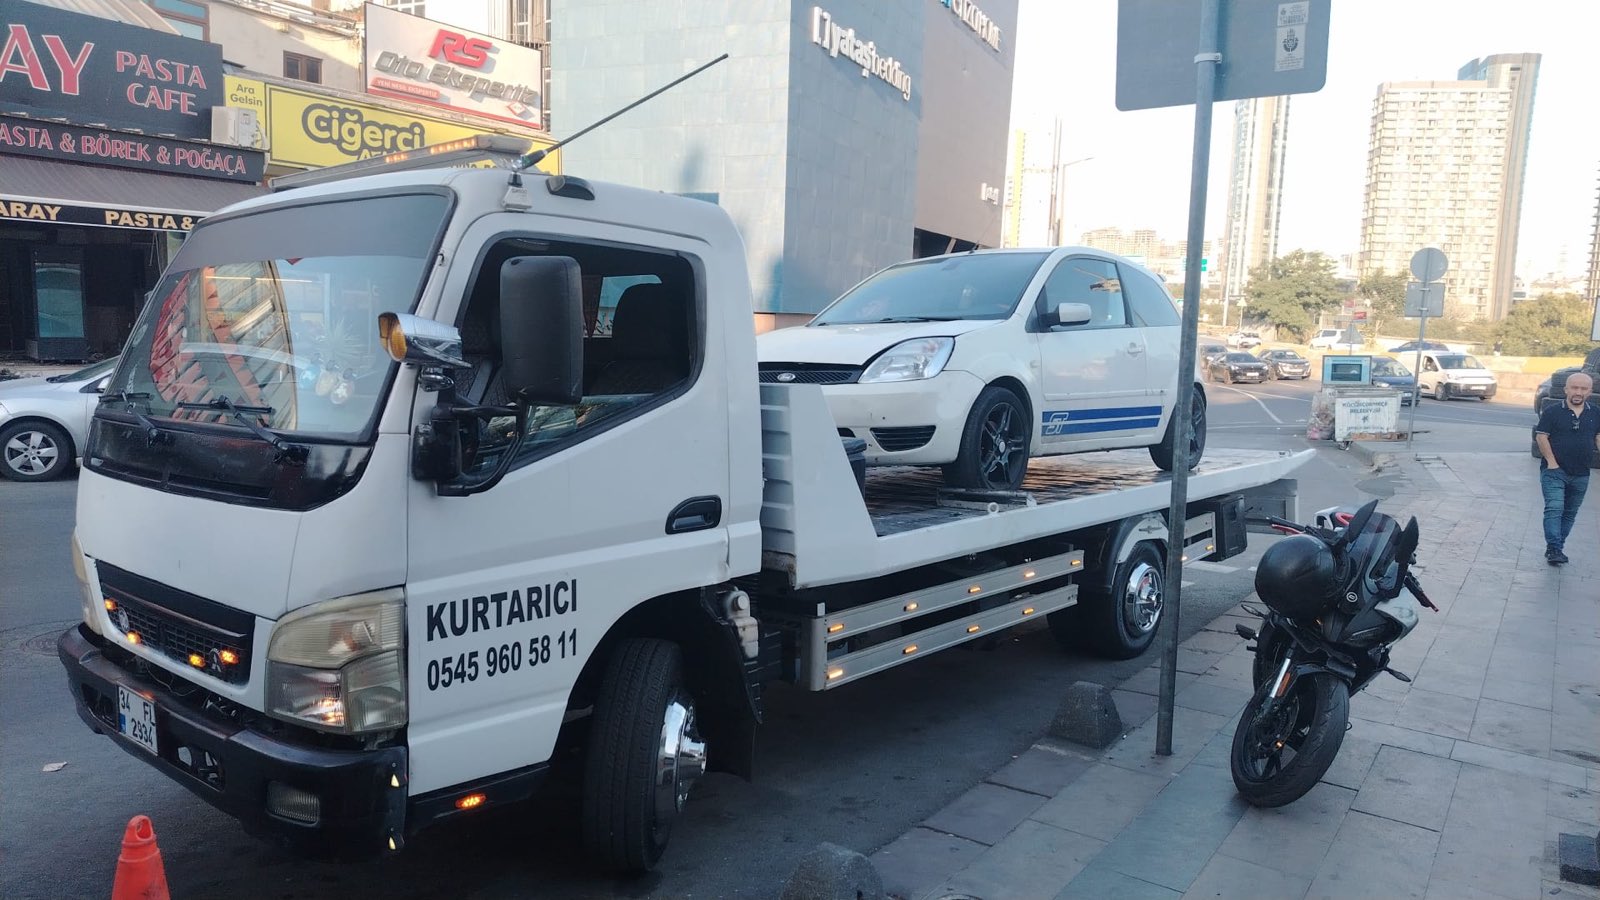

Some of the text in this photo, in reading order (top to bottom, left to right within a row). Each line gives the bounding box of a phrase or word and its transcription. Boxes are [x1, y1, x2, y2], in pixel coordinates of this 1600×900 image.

[428, 29, 493, 68] RS
[116, 50, 207, 90] PASTA
[237, 83, 255, 95] Ara
[375, 51, 538, 105] Oto Ekspertiz
[126, 82, 199, 117] CAFE
[230, 93, 263, 107] Gelsin
[303, 104, 424, 153] Ciğerci
[60, 132, 77, 154] &
[81, 132, 151, 162] BÖREK
[156, 145, 171, 165] &
[175, 147, 247, 176] POĞAÇA
[105, 210, 178, 230] PASTA
[180, 216, 195, 230] &
[1045, 412, 1070, 435] ST
[426, 578, 577, 642] KURTARICI
[427, 627, 577, 692] 0545 960 58 11
[120, 689, 156, 727] 34 FL
